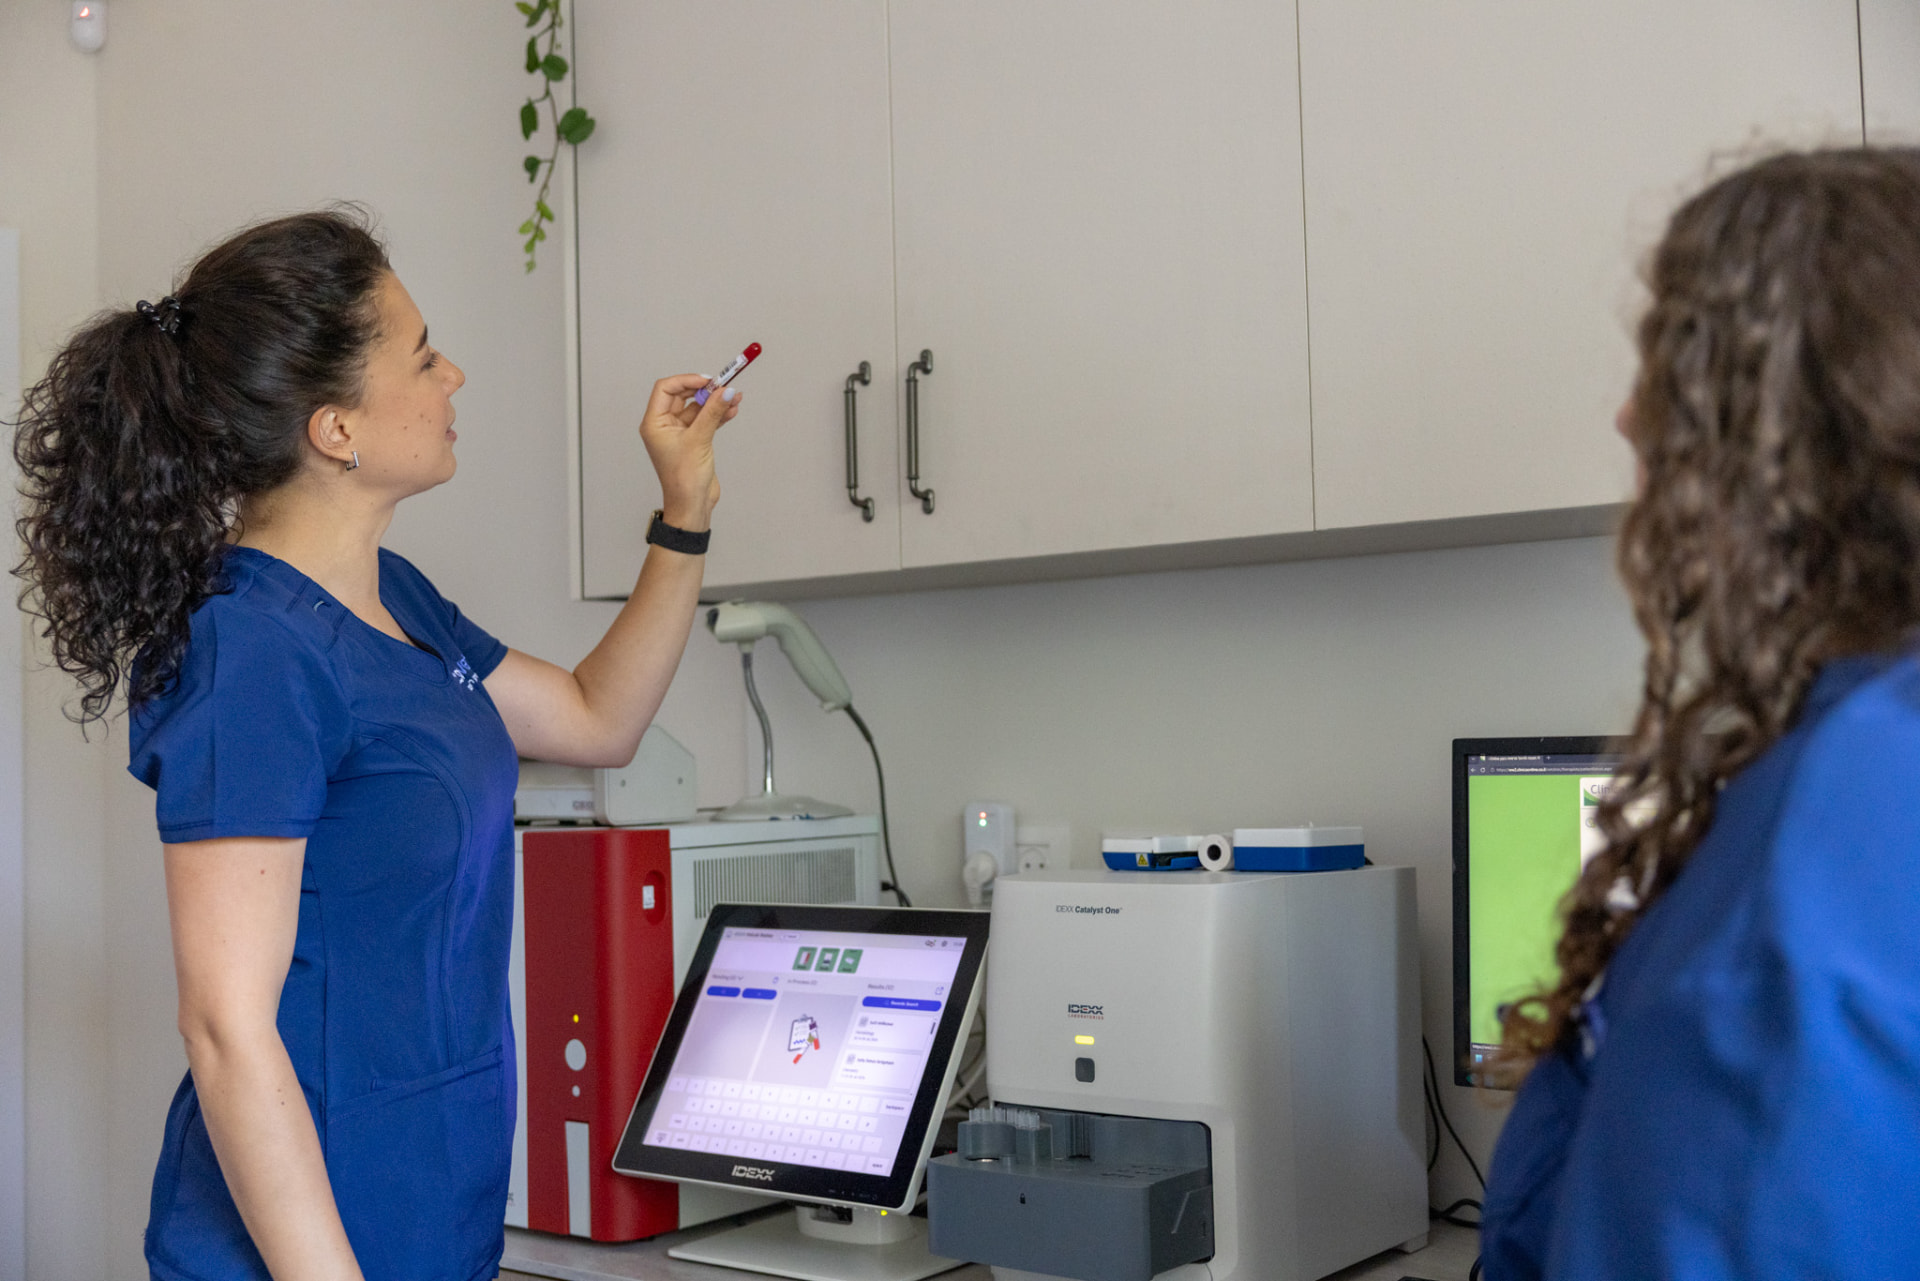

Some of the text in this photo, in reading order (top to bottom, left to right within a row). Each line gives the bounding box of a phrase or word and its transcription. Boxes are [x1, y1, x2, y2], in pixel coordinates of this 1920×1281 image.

[1056, 905, 1074, 913] IDEXX
[1075, 905, 1104, 915] Catalyst
[1068, 1003, 1104, 1015] IDEXX
[731, 1164, 775, 1182] IDEXX
